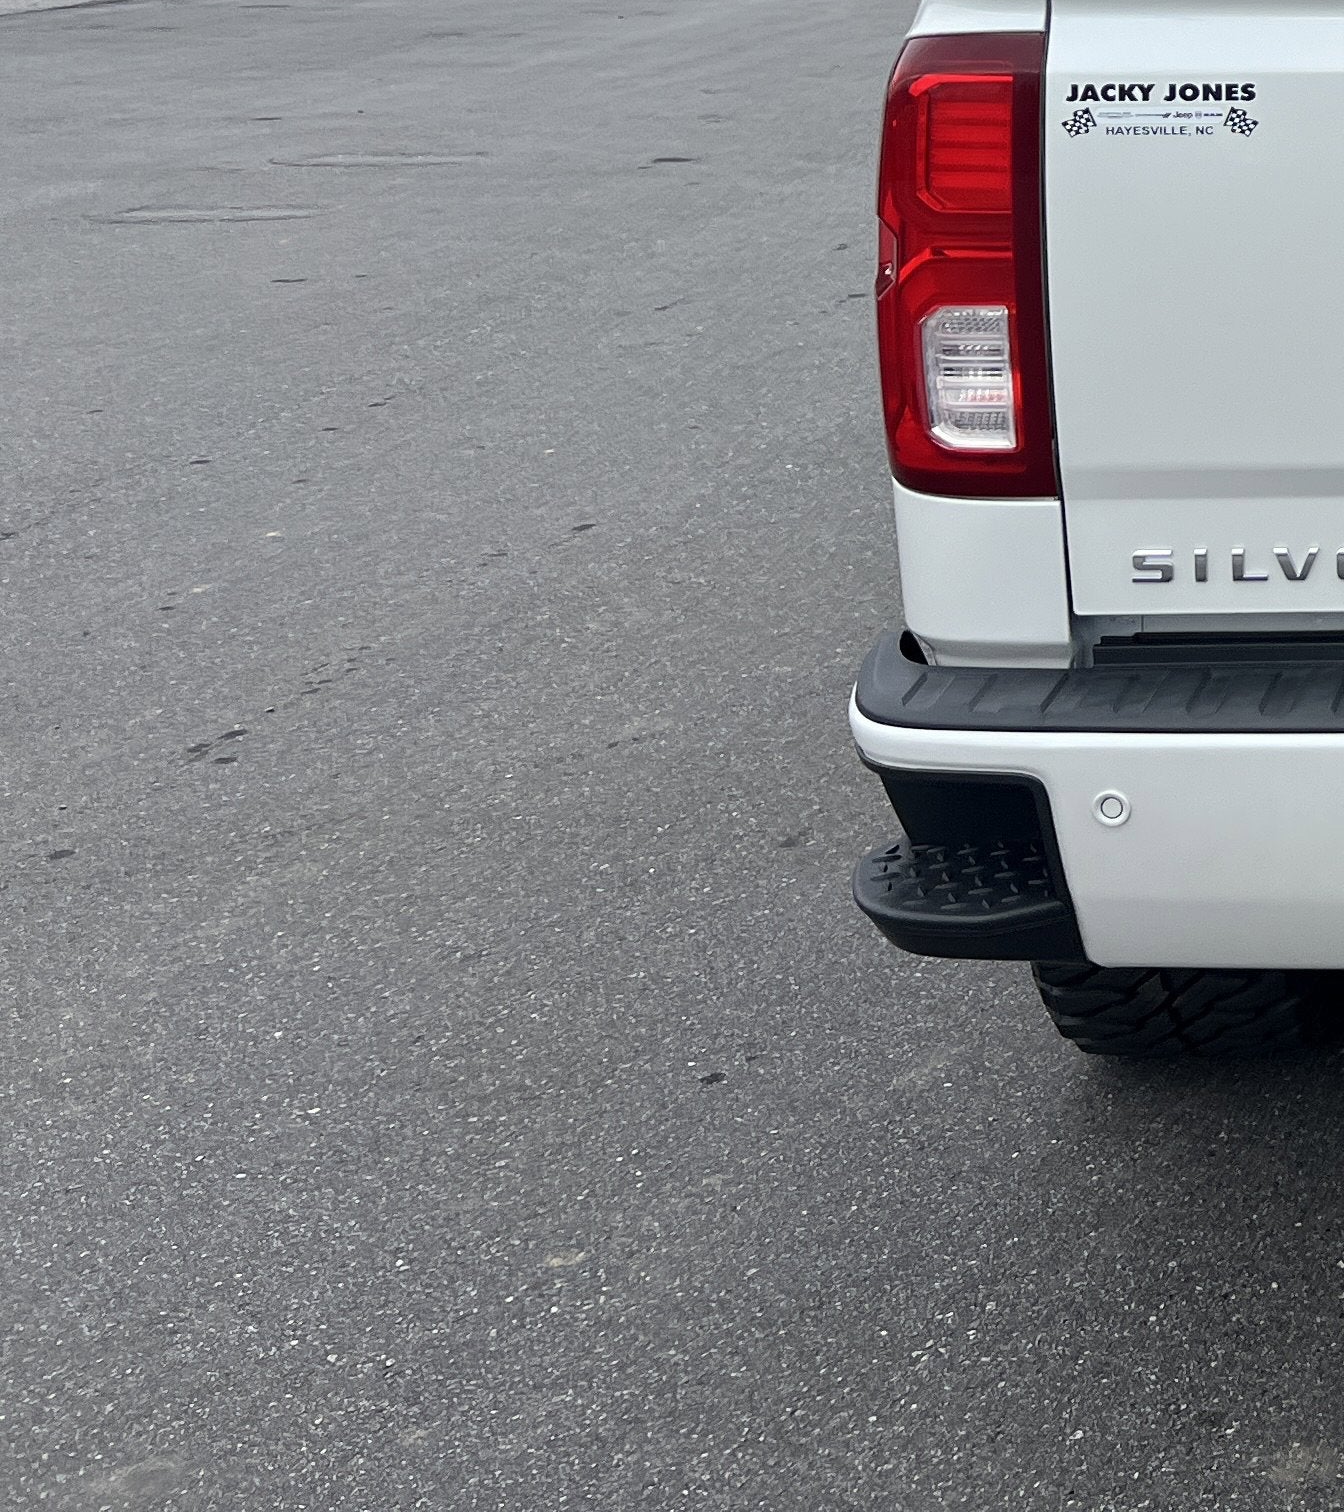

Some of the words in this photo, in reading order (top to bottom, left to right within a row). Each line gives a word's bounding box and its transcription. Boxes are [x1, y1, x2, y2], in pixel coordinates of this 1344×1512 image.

[1066, 84, 1155, 101] JACKY
[1164, 84, 1256, 101] JONES
[1106, 127, 1191, 136] HAYESVILLE,
[1196, 127, 1214, 135] NC
